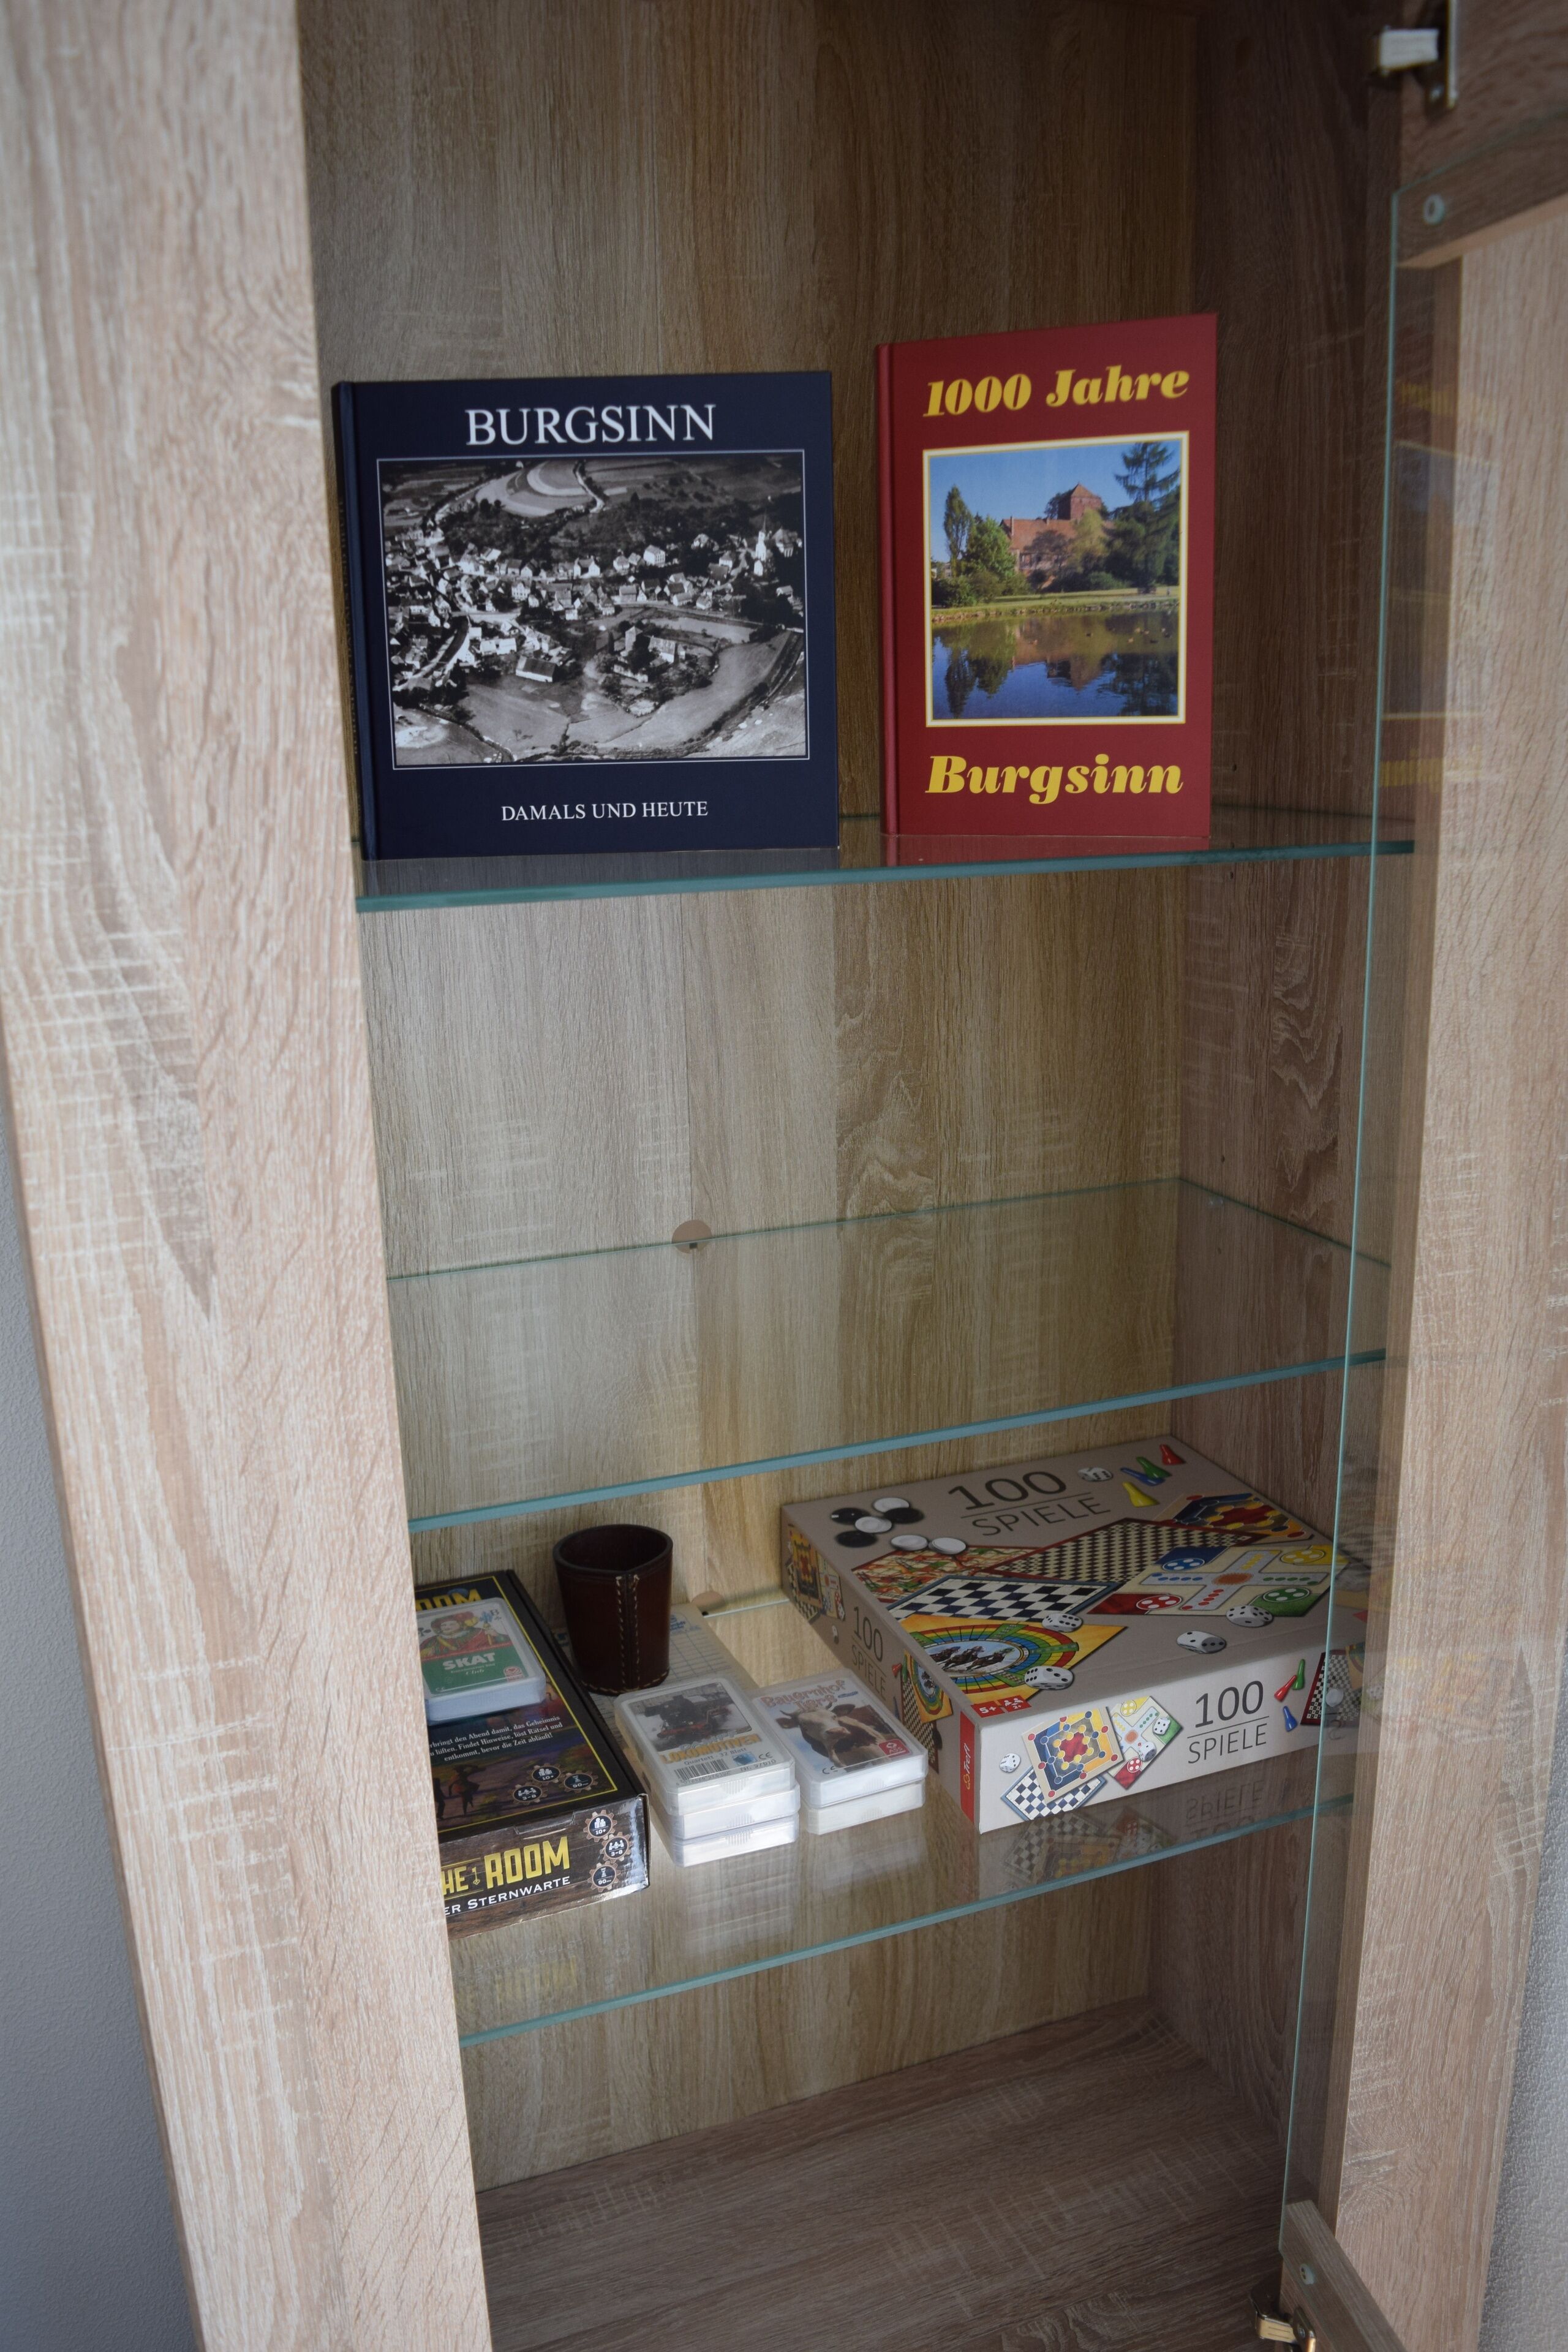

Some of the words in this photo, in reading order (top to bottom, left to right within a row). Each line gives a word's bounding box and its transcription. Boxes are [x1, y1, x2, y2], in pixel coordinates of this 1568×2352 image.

[922, 374, 1032, 417] 1000
[1046, 365, 1189, 407] Jahre
[466, 404, 716, 446] BURGSINN
[924, 754, 1183, 805] Burgsinn
[501, 804, 586, 821] DAMALS
[592, 802, 636, 820] UND
[642, 801, 708, 818] HEUTE
[948, 1471, 1067, 1510] 100
[972, 1497, 1110, 1536] SPIELE
[415, 1588, 482, 1611] OOM
[854, 1607, 883, 1662] 100
[442, 1653, 496, 1670] SKAT
[851, 1644, 886, 1702] SPIELE
[760, 1679, 845, 1708] Bauernhof
[1195, 1680, 1264, 1728] 100
[429, 1739, 453, 1749] rbringt
[469, 1730, 490, 1740] Abend
[491, 1726, 513, 1735] damit,
[526, 1716, 560, 1727] Geheimnis
[435, 1747, 458, 1755] lüften.
[458, 1741, 480, 1751] Findet
[480, 1734, 514, 1746] Hinweise,
[527, 1725, 549, 1736] Rätsel
[550, 1722, 564, 1730] und
[444, 1750, 481, 1762] entkommt,
[513, 1738, 527, 1747] Zeit
[1188, 1723, 1267, 1764] SPIELE
[684, 1755, 714, 1766] Quartett
[440, 1866, 469, 1896] HE
[484, 1836, 570, 1889] ROOM
[444, 1904, 461, 1916] ER
[467, 1875, 571, 1910] STERNWARTE
